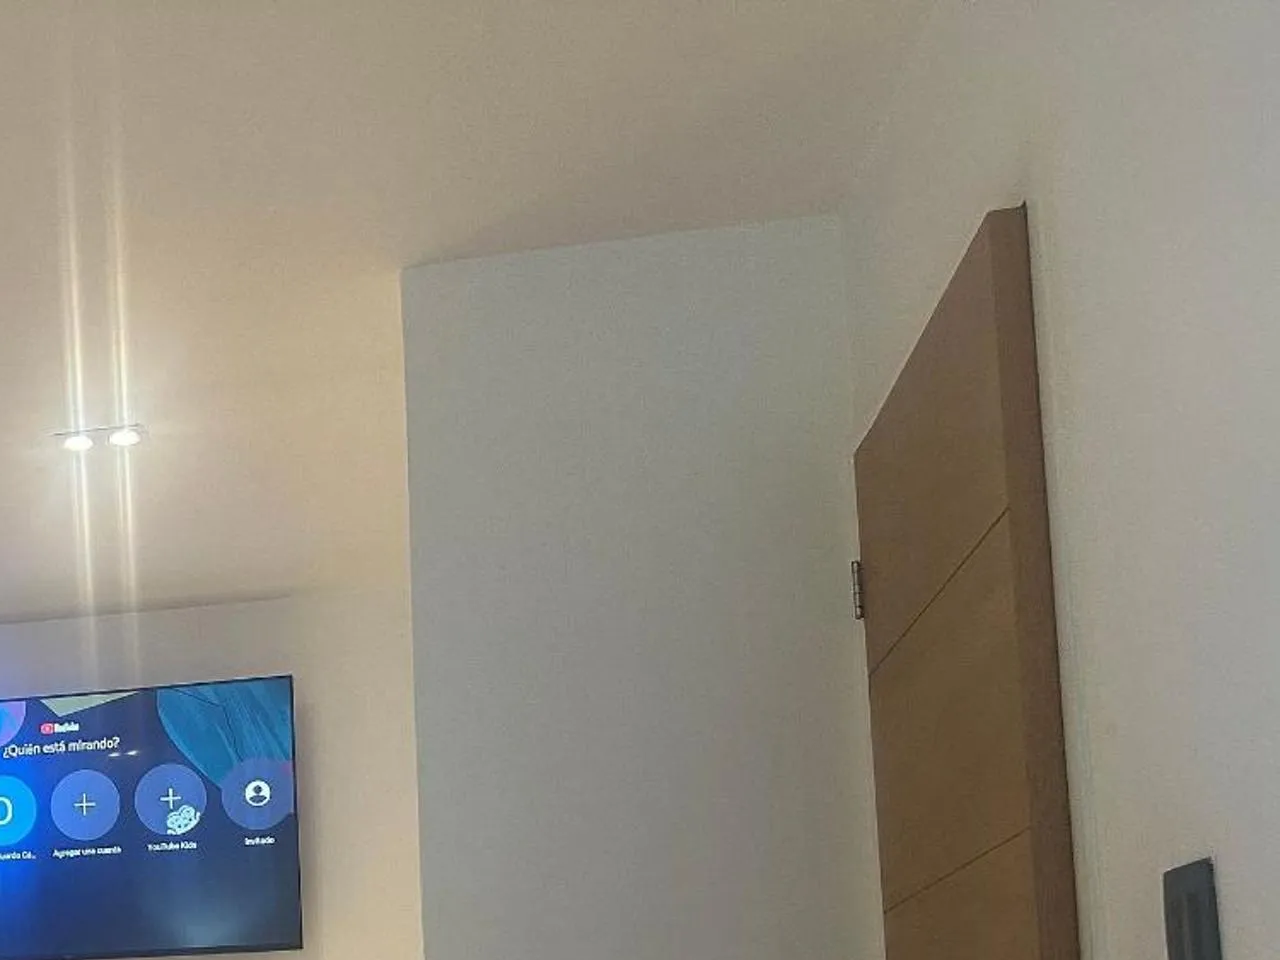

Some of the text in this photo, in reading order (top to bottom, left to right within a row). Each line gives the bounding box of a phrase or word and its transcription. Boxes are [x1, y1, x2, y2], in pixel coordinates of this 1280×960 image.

[2, 736, 120, 758] ¿Quién está mirando?
